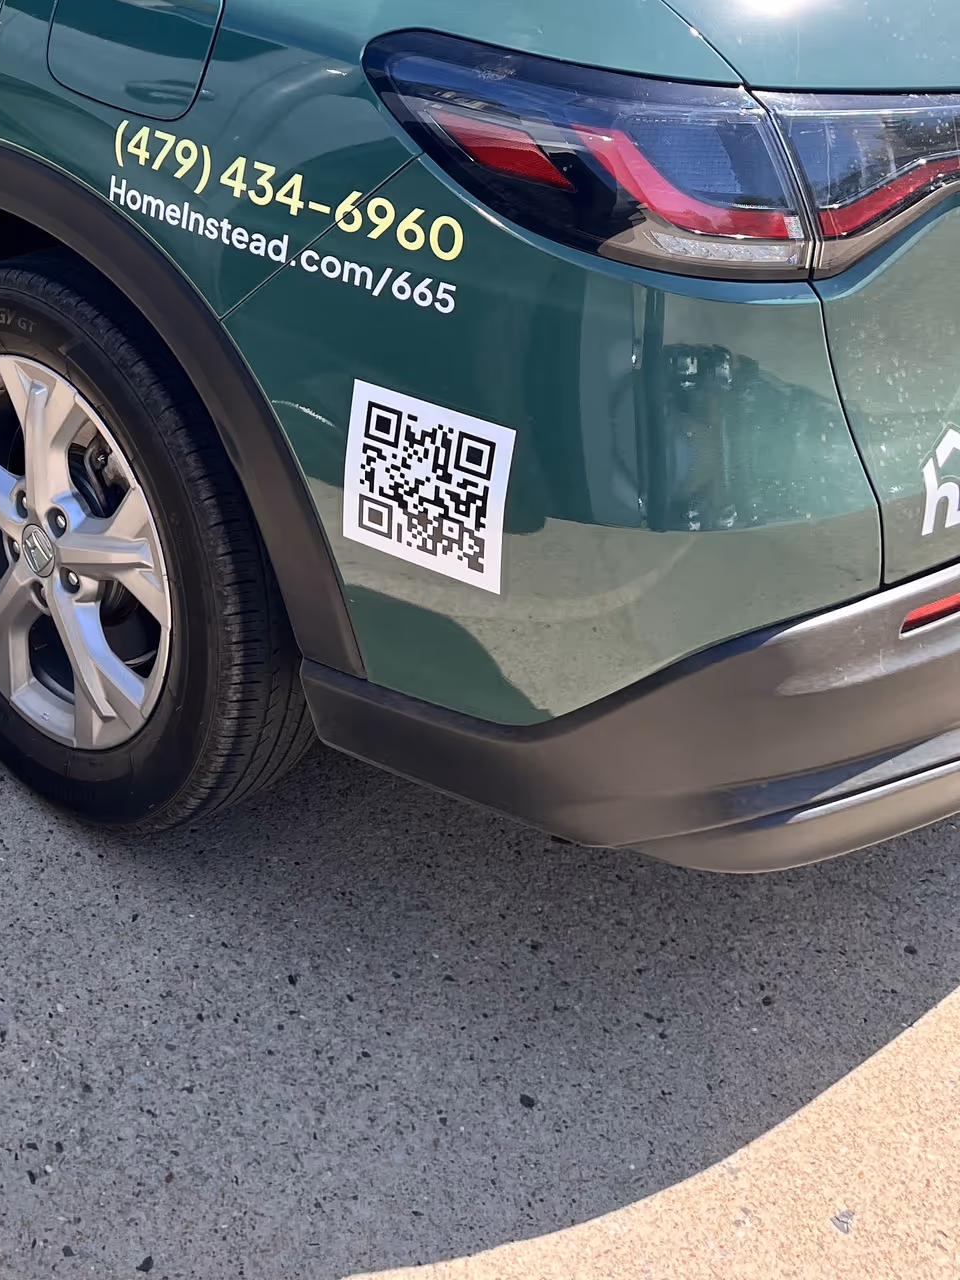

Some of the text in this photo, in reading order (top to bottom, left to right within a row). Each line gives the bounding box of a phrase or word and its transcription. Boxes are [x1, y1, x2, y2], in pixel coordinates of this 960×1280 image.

[108, 174, 458, 315] HomeInstead.com/665
[114, 119, 465, 262] (479) 434-6960
[17, 316, 38, 333] GT
